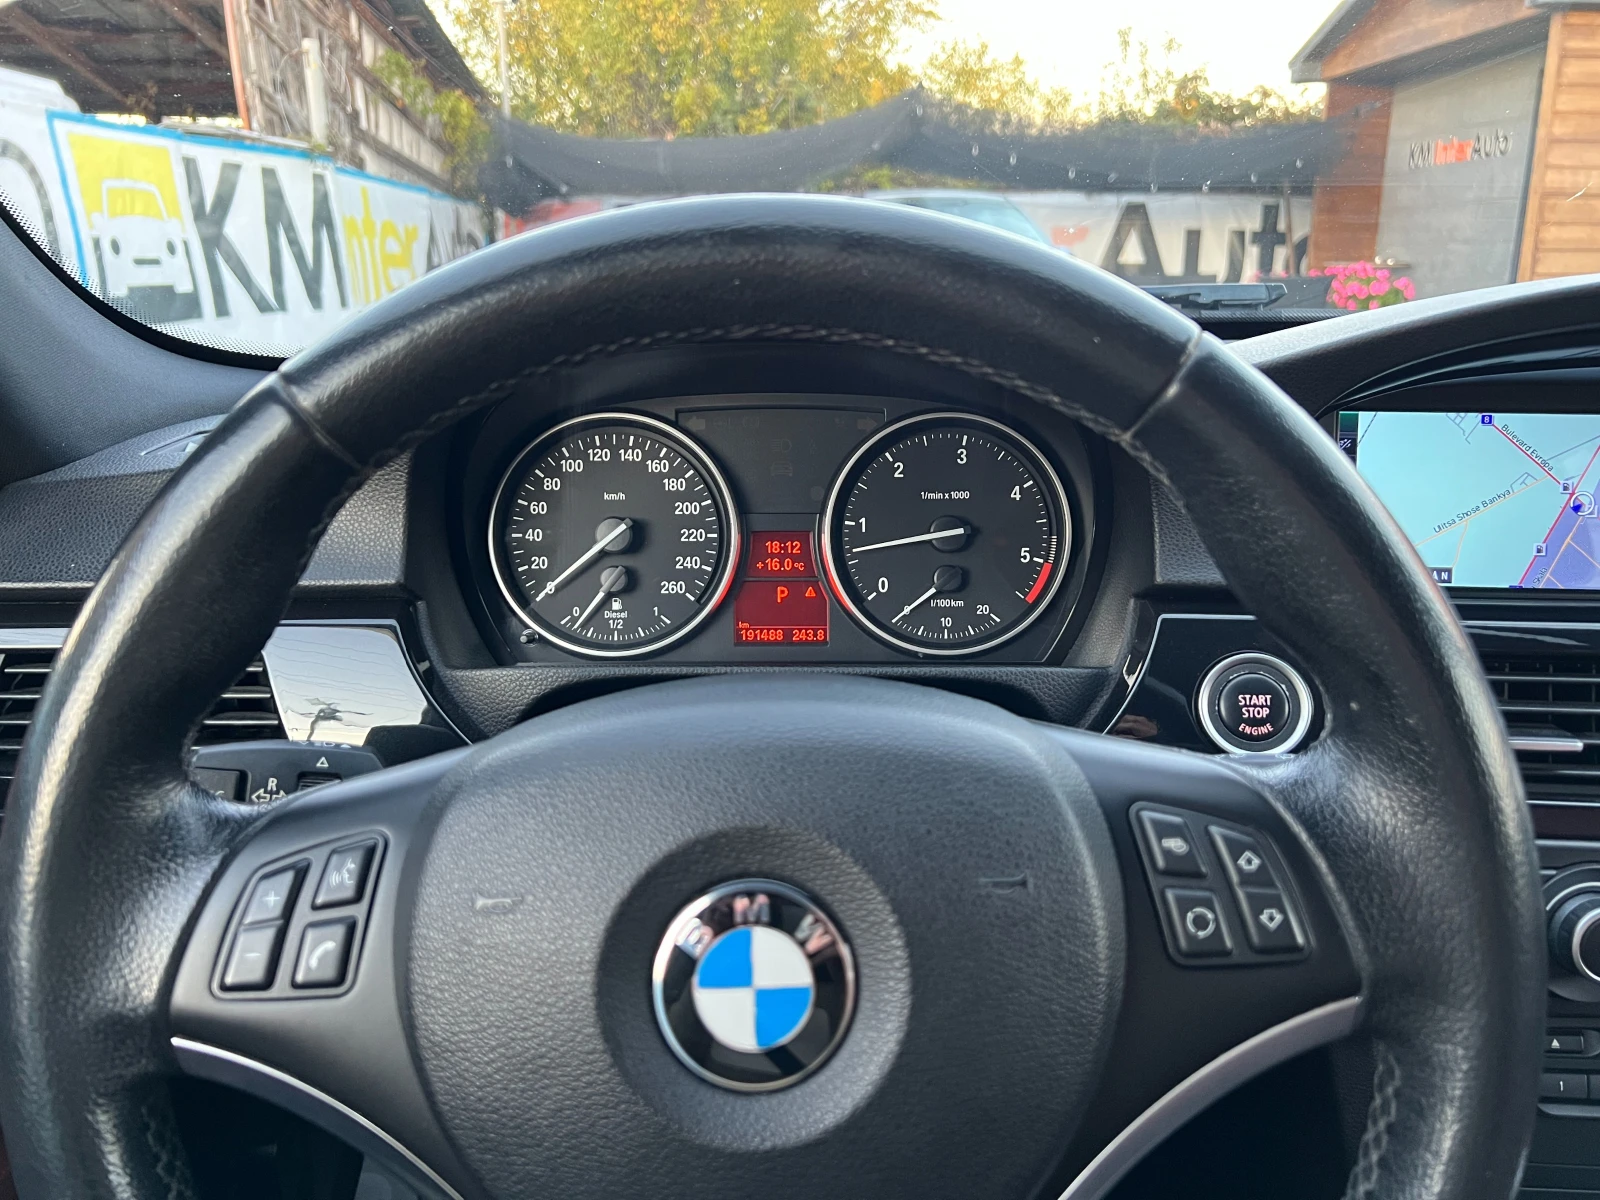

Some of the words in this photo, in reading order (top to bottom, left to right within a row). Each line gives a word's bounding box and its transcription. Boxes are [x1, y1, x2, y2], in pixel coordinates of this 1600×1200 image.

[1484, 415, 1490, 424] 8
[1501, 424, 1532, 452] Bulevard
[1530, 449, 1554, 471] Evropa
[588, 449, 610, 461] 120
[619, 449, 642, 461] 140
[957, 449, 966, 464] 3
[561, 460, 583, 472] 100
[646, 460, 669, 472] 160
[894, 462, 903, 477] 2
[544, 478, 560, 490] 80
[662, 478, 686, 490] 180
[604, 492, 625, 500] km/h
[920, 491, 943, 500] 1/min
[950, 490, 970, 499] 1000
[1011, 486, 1021, 500] 4
[530, 502, 547, 514] 60
[675, 502, 699, 514] 200
[1433, 518, 1456, 533] Ulitsa
[1456, 505, 1481, 521] Shose
[1480, 489, 1511, 508] Bankya
[859, 518, 865, 532] 1
[525, 529, 542, 541] 40
[681, 529, 705, 541] 220
[766, 541, 800, 553] 18:12
[1021, 548, 1030, 562] 5
[531, 557, 547, 569] 20
[676, 557, 700, 569] 240
[660, 581, 685, 594] 260
[878, 577, 888, 592] 0
[777, 587, 788, 602] P
[573, 607, 579, 616] 0
[605, 609, 627, 620] Diesel
[653, 606, 659, 617] 1
[977, 605, 991, 615] 20
[609, 619, 623, 628] 1/2
[941, 617, 951, 627] 10
[740, 629, 784, 641] 191488
[792, 629, 825, 641] 243.8
[1238, 694, 1272, 706] START
[1242, 707, 1270, 718] STOP
[1238, 722, 1274, 736] ENGINE
[267, 777, 278, 791] R
[675, 893, 834, 960] BMW
[1559, 1080, 1564, 1092] 1
